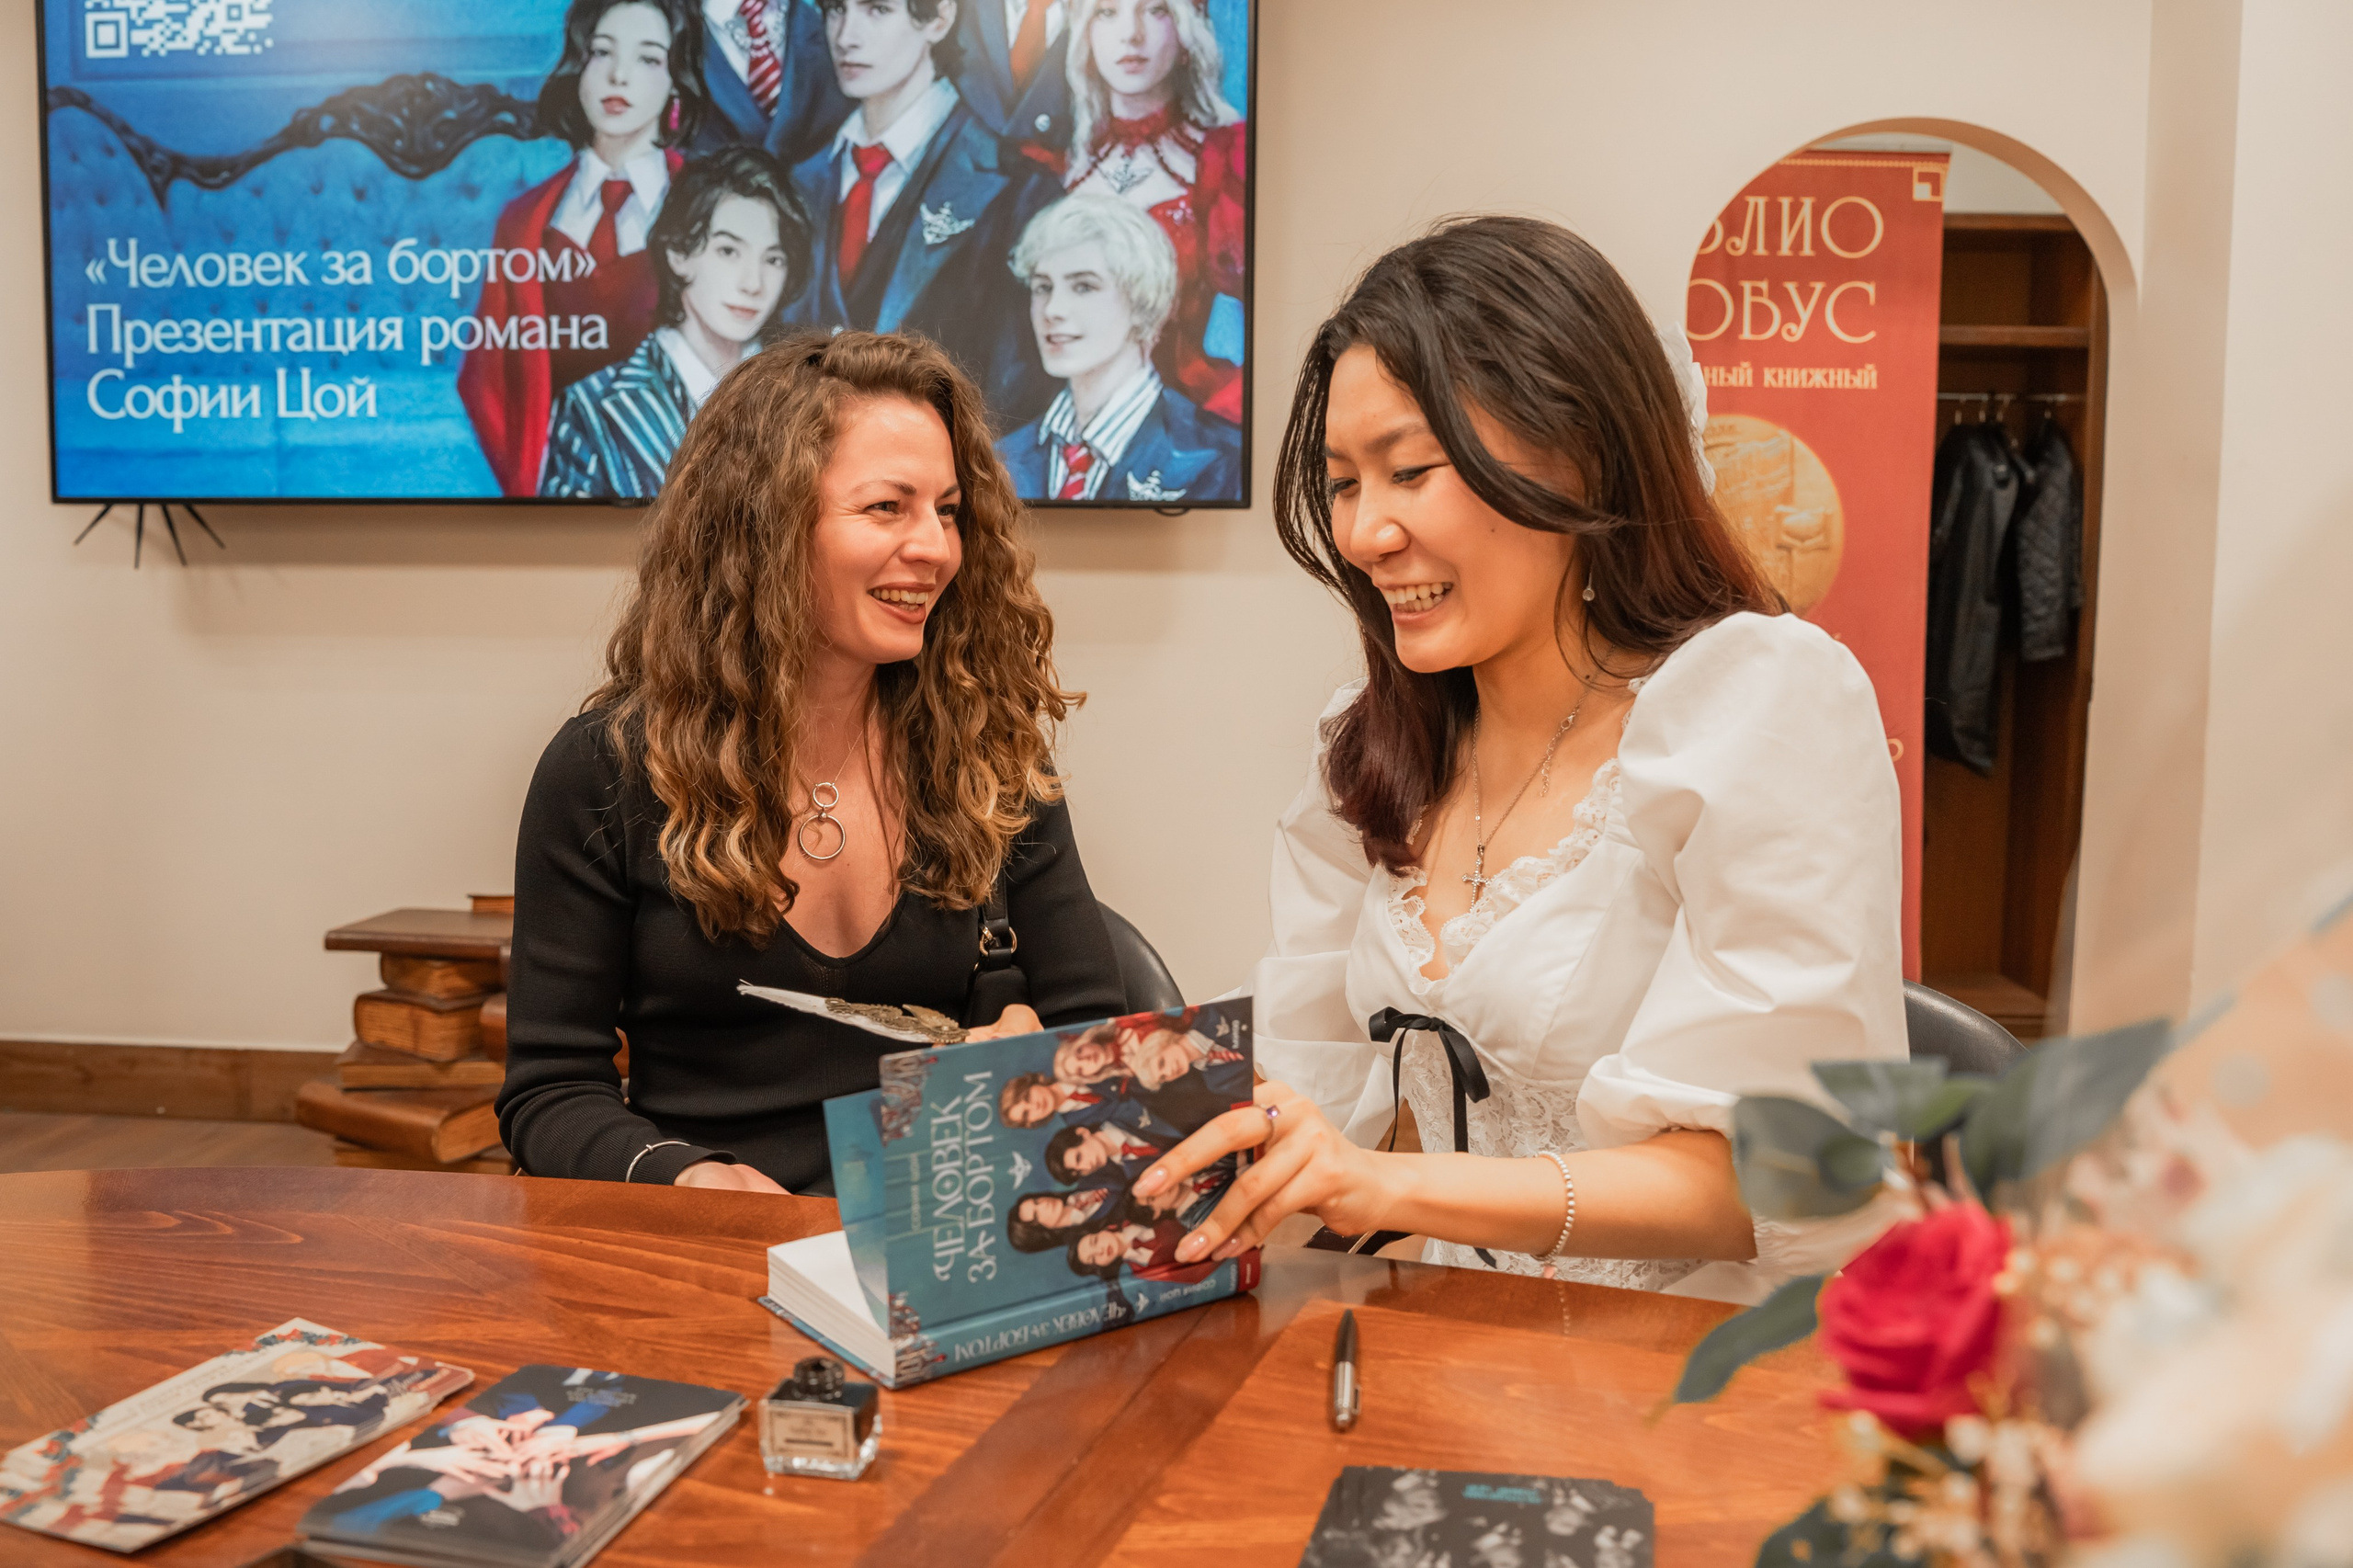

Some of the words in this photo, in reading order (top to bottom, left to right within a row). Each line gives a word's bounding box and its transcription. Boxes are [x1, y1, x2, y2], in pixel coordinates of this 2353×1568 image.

[85, 238, 312, 289] «Человек
[321, 251, 371, 285] за
[387, 238, 597, 299] бортом»
[86, 303, 404, 368] Презентация
[420, 314, 609, 366] романа
[1687, 278, 1877, 344] ОБУС
[86, 368, 262, 434] Софии
[276, 368, 379, 422] Цой
[963, 1071, 995, 1229] БОРТОМ
[930, 1095, 965, 1281] ЧЕЛОВЕК
